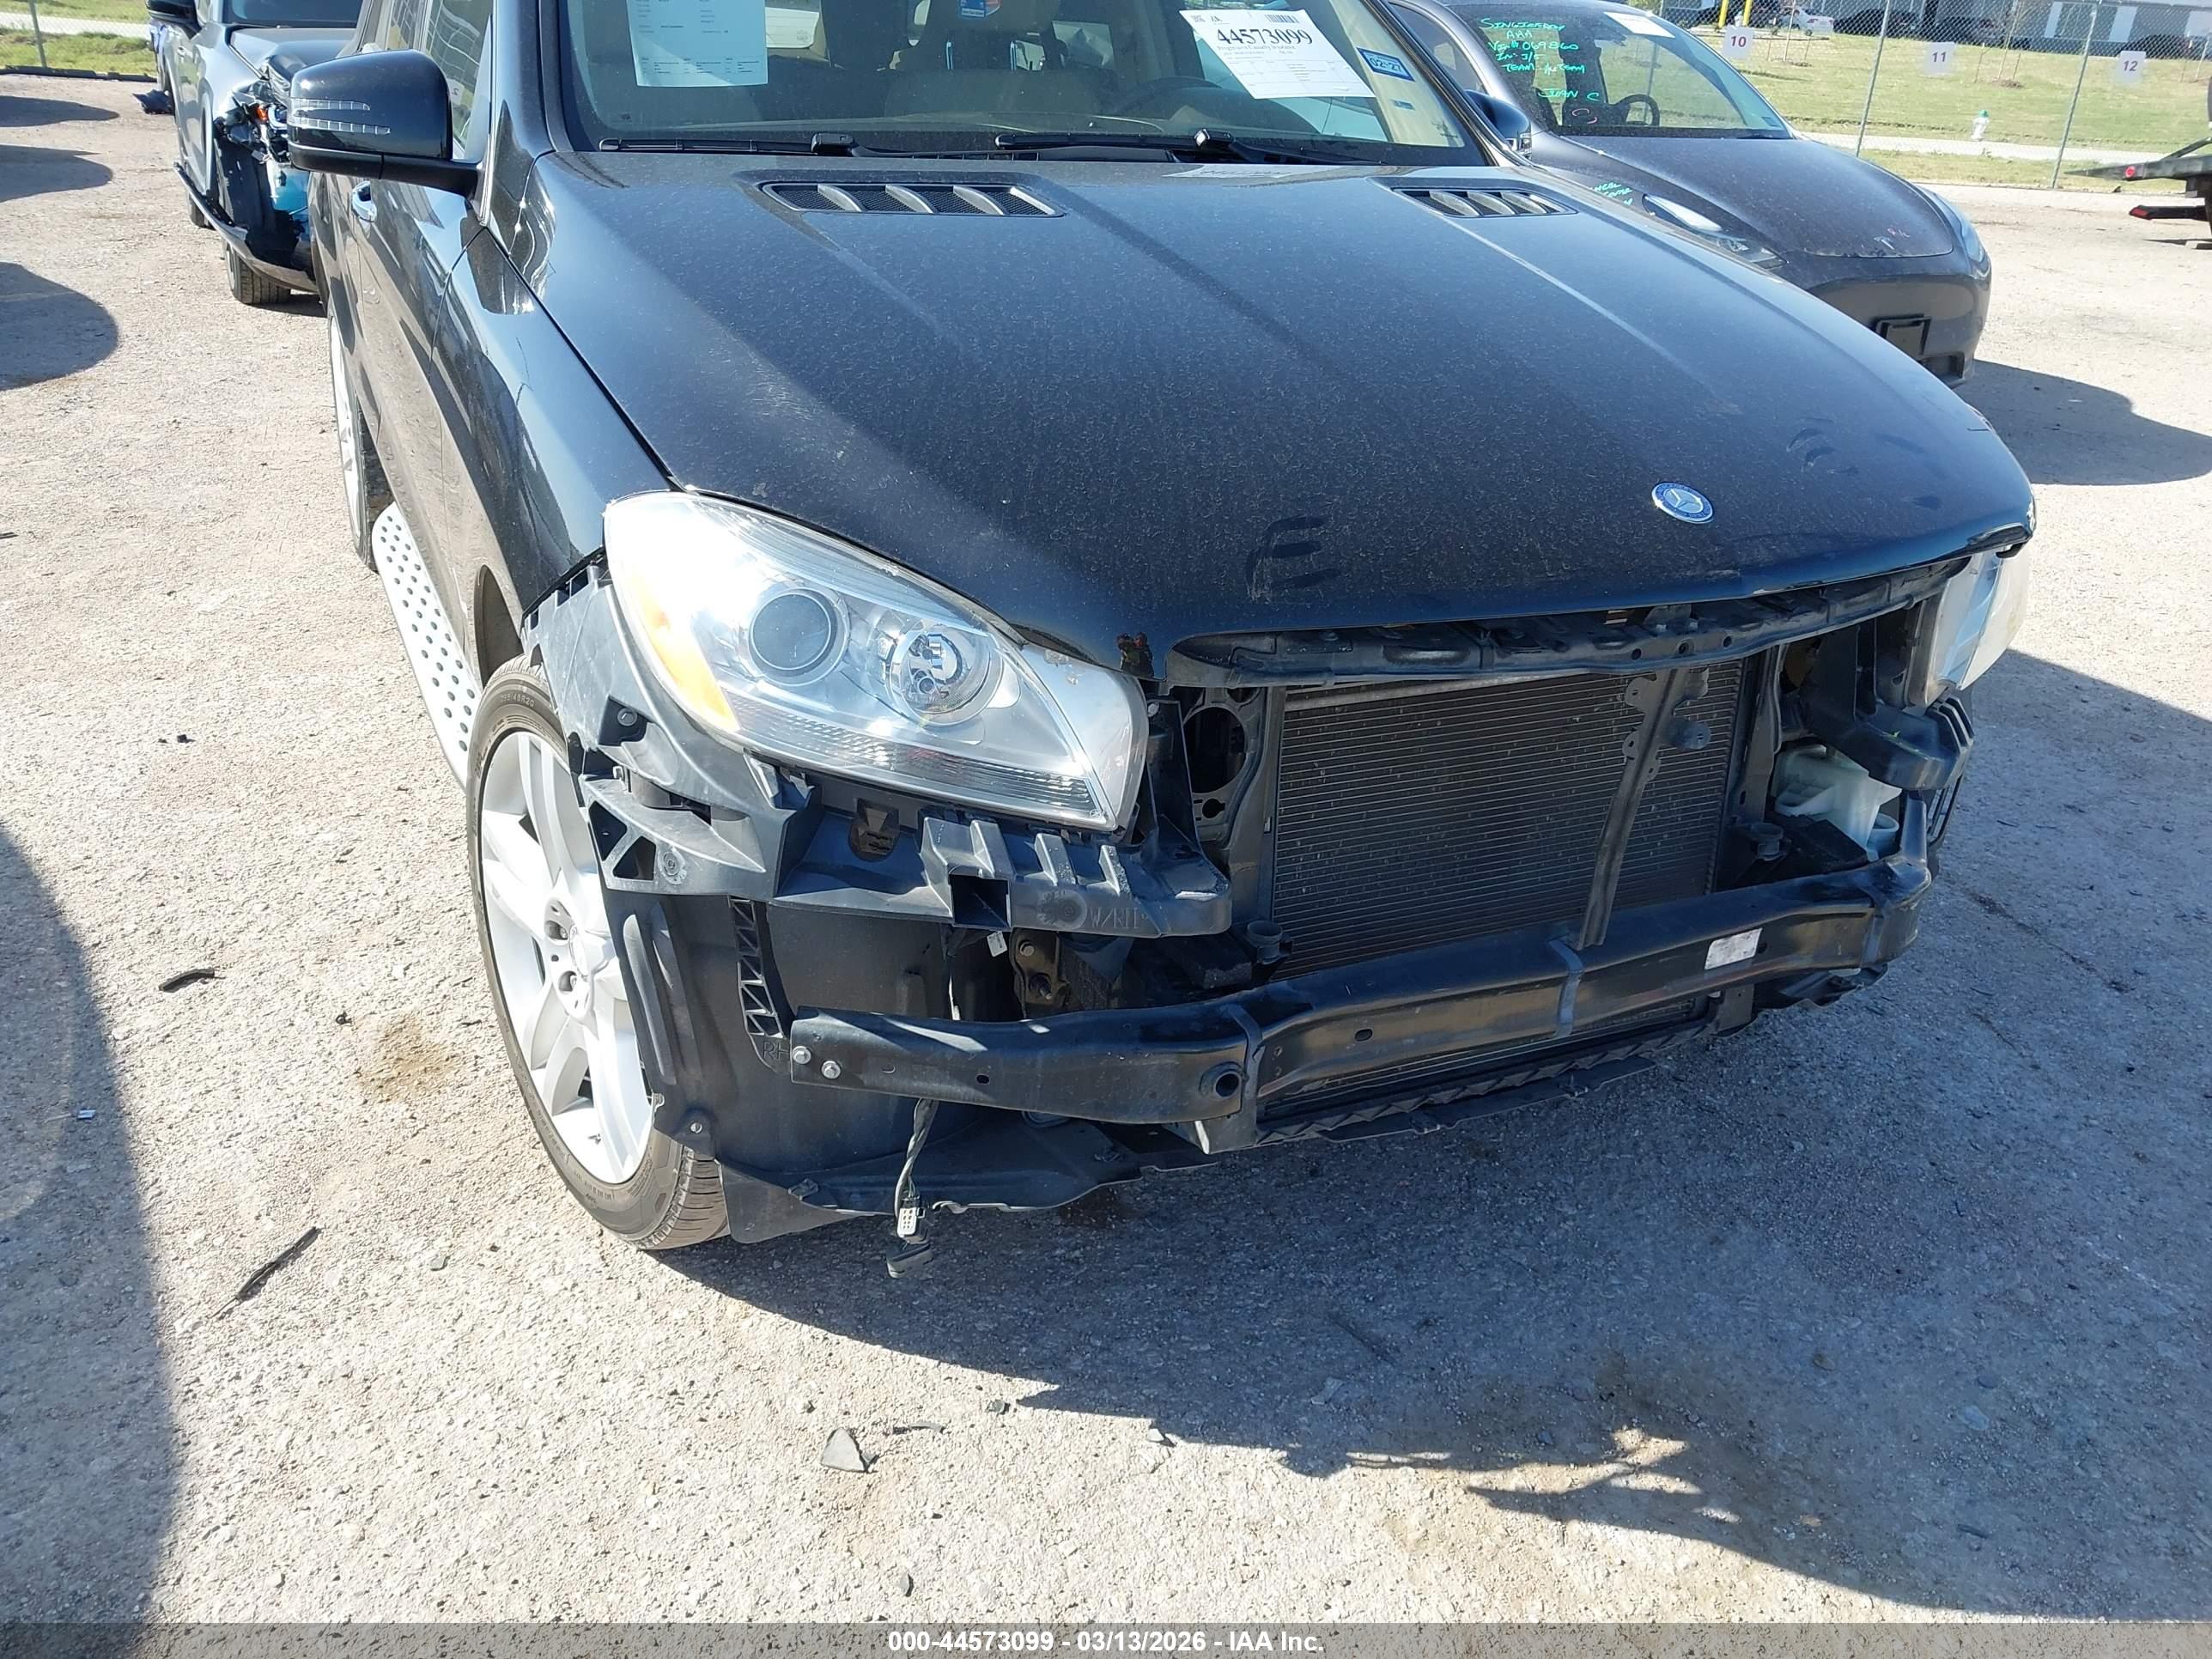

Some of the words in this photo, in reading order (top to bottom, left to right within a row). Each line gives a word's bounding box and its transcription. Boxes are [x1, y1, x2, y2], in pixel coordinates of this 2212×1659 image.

[1218, 28, 1312, 44] 44573099
[1730, 35, 1747, 48] 10
[1932, 52, 1947, 63] 11
[2124, 60, 2138, 71] 12
